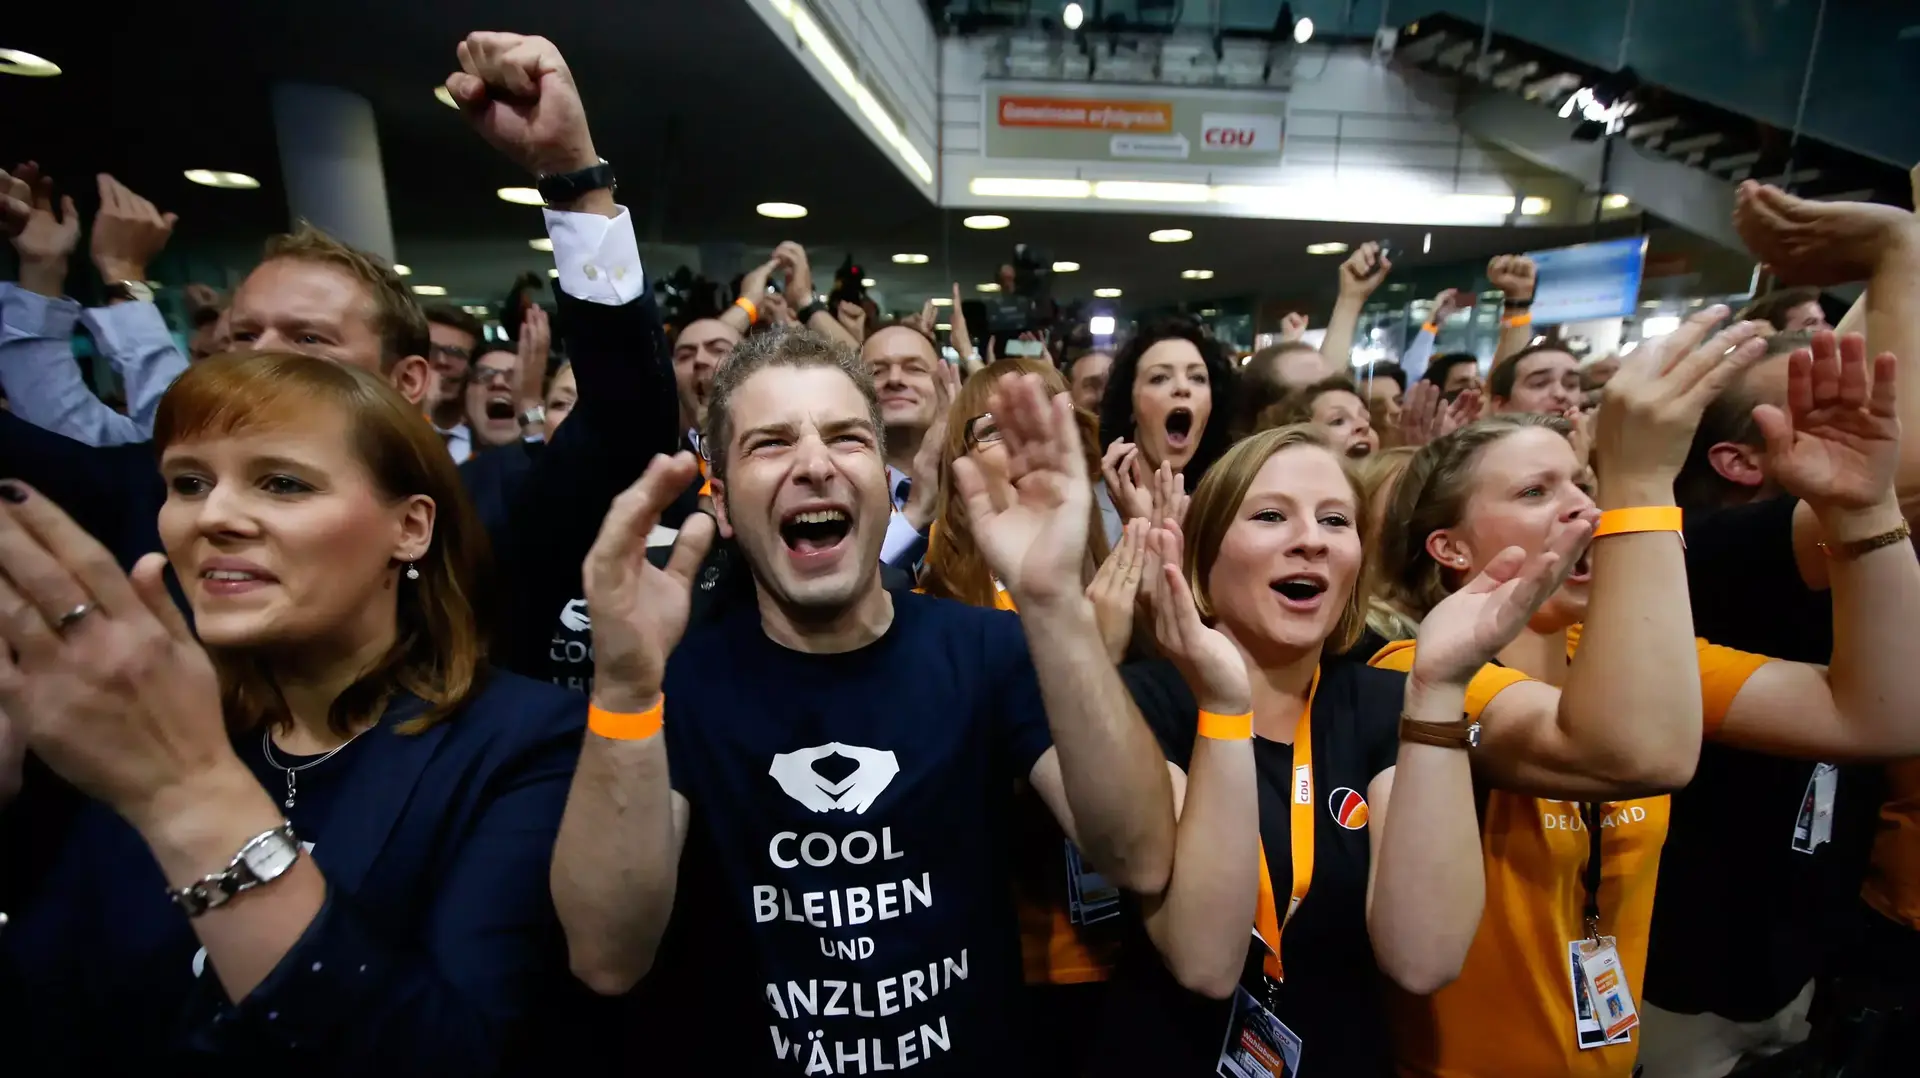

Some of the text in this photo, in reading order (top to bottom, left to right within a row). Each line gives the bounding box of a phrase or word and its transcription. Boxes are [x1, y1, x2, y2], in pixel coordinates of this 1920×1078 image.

[1205, 127, 1255, 148] CDU
[1301, 780, 1309, 802] CDU
[769, 826, 904, 868] COOL
[753, 872, 932, 928] BLEIBEN
[820, 937, 875, 961] UND
[765, 948, 969, 1019] ANZLERIN
